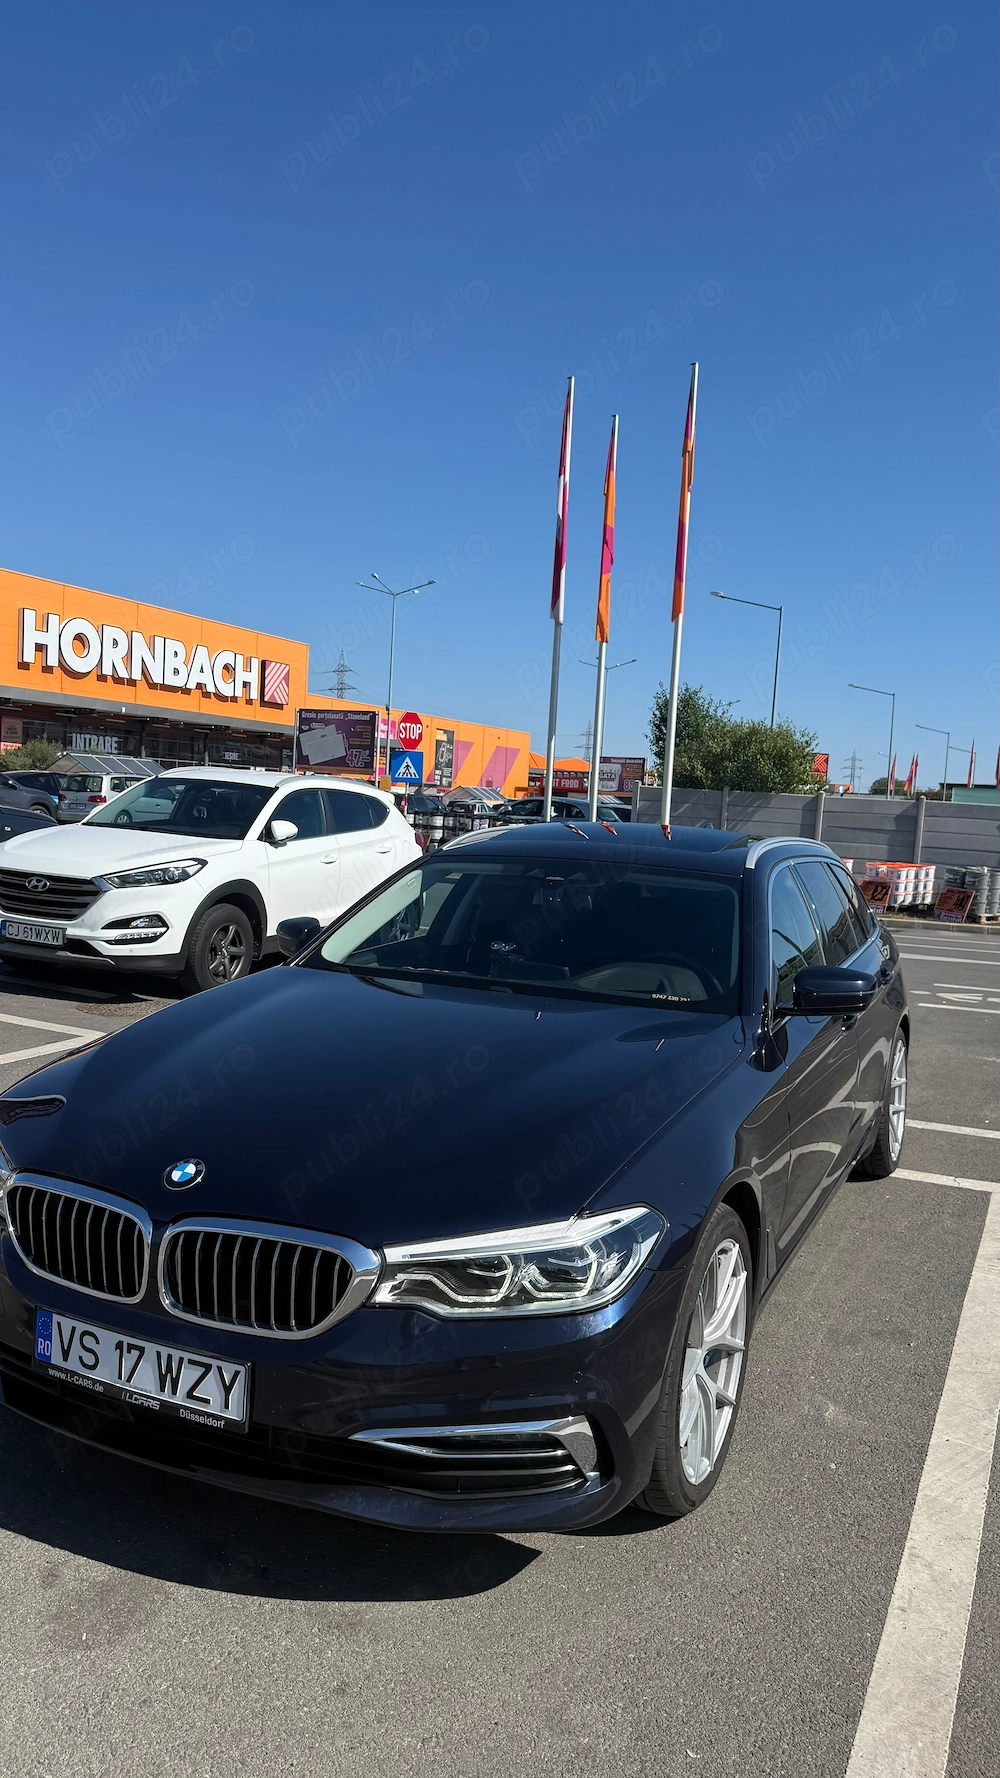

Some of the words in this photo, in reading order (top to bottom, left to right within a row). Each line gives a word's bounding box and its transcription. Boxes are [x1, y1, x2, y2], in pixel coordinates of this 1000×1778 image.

[19, 607, 259, 701] HORNBACH
[399, 722, 423, 740] STOP
[71, 732, 119, 754] INTRARE
[561, 778, 579, 788] FOOD
[7, 923, 20, 937] CJ
[37, 1337, 52, 1357] RO
[56, 1321, 101, 1371] VS
[114, 1340, 146, 1384] 17
[155, 1350, 242, 1411] WZY
[48, 1368, 105, 1393] www.L-CARS.de
[179, 1408, 226, 1430] Düsseldorf
